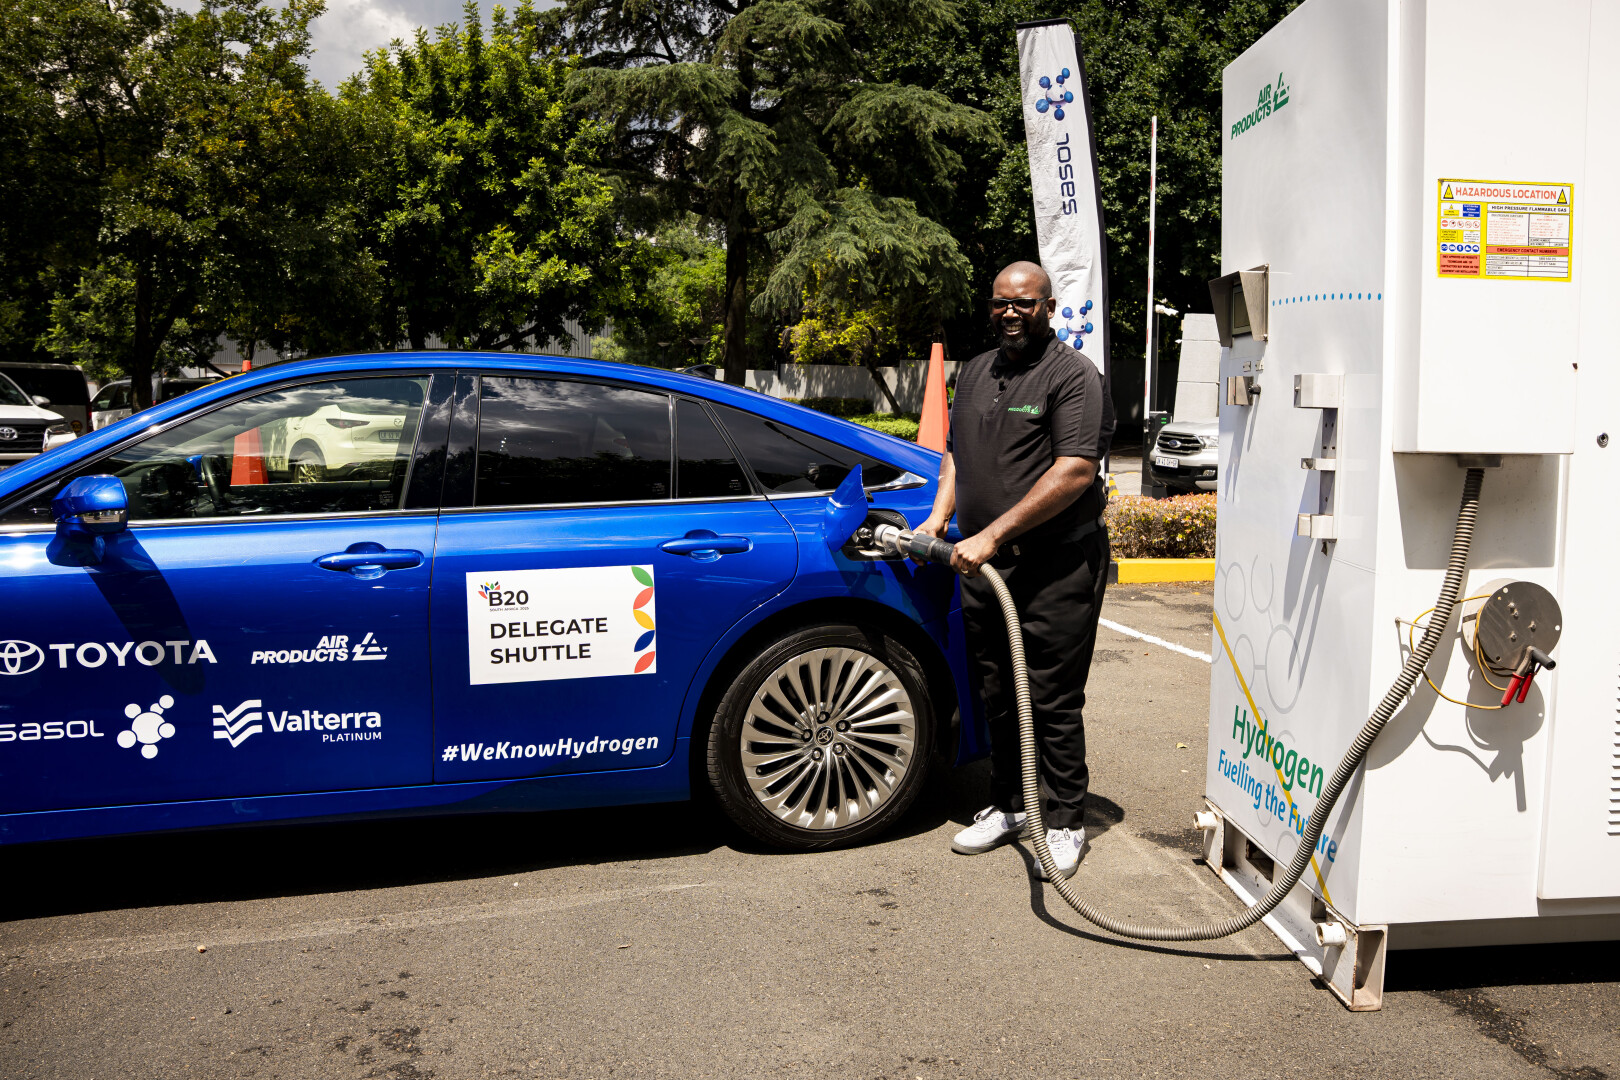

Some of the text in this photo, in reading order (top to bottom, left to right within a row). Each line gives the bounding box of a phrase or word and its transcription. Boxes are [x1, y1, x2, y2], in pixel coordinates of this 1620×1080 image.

[1257, 84, 1272, 107] AIR
[1231, 100, 1272, 140] PRODUCTS
[1455, 186, 1557, 200] HAZARDOUS LOCATION
[488, 590, 529, 606] B20
[490, 617, 609, 639] DELEGATE
[316, 635, 349, 649] AIR
[49, 639, 218, 668] TOYOTA
[251, 648, 349, 664] PRODUCTS
[490, 643, 592, 664] SHUTTLE
[267, 710, 382, 732] Valterra
[322, 732, 382, 742] PLATINUM
[442, 736, 659, 761] #WeKnowHydrogen
[1232, 704, 1324, 799] Hydrogen
[1218, 749, 1338, 863] Fuelling the Fure
